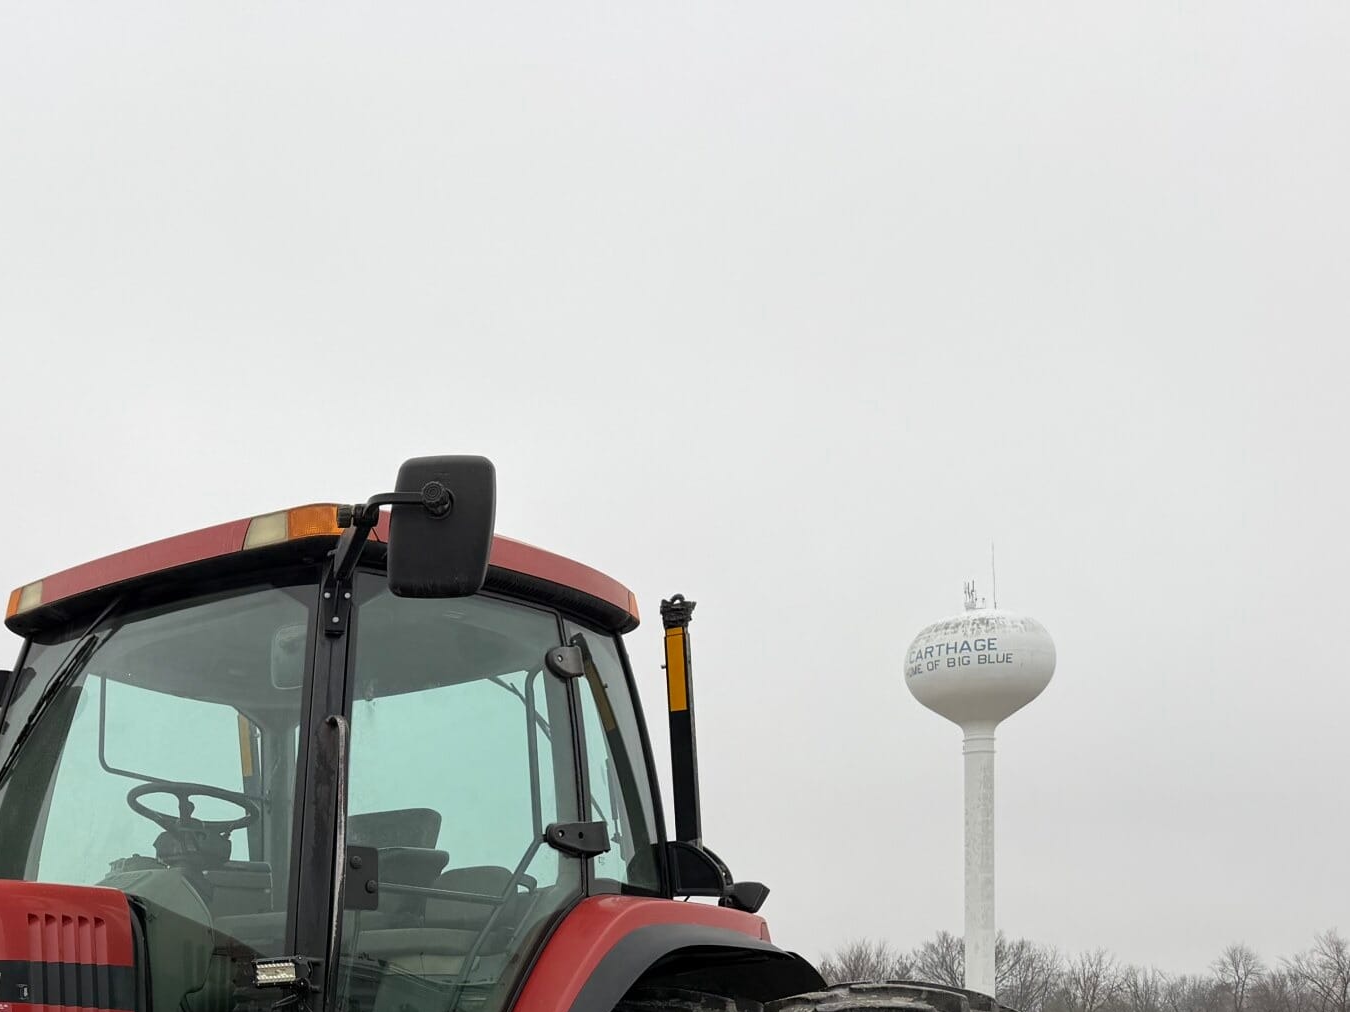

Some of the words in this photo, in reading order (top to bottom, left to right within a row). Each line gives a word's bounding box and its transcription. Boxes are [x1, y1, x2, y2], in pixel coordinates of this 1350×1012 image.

[908, 638, 998, 664] CARTHAGE
[926, 659, 941, 672] OF
[946, 655, 971, 668] BIG
[977, 653, 1014, 665] BLUE
